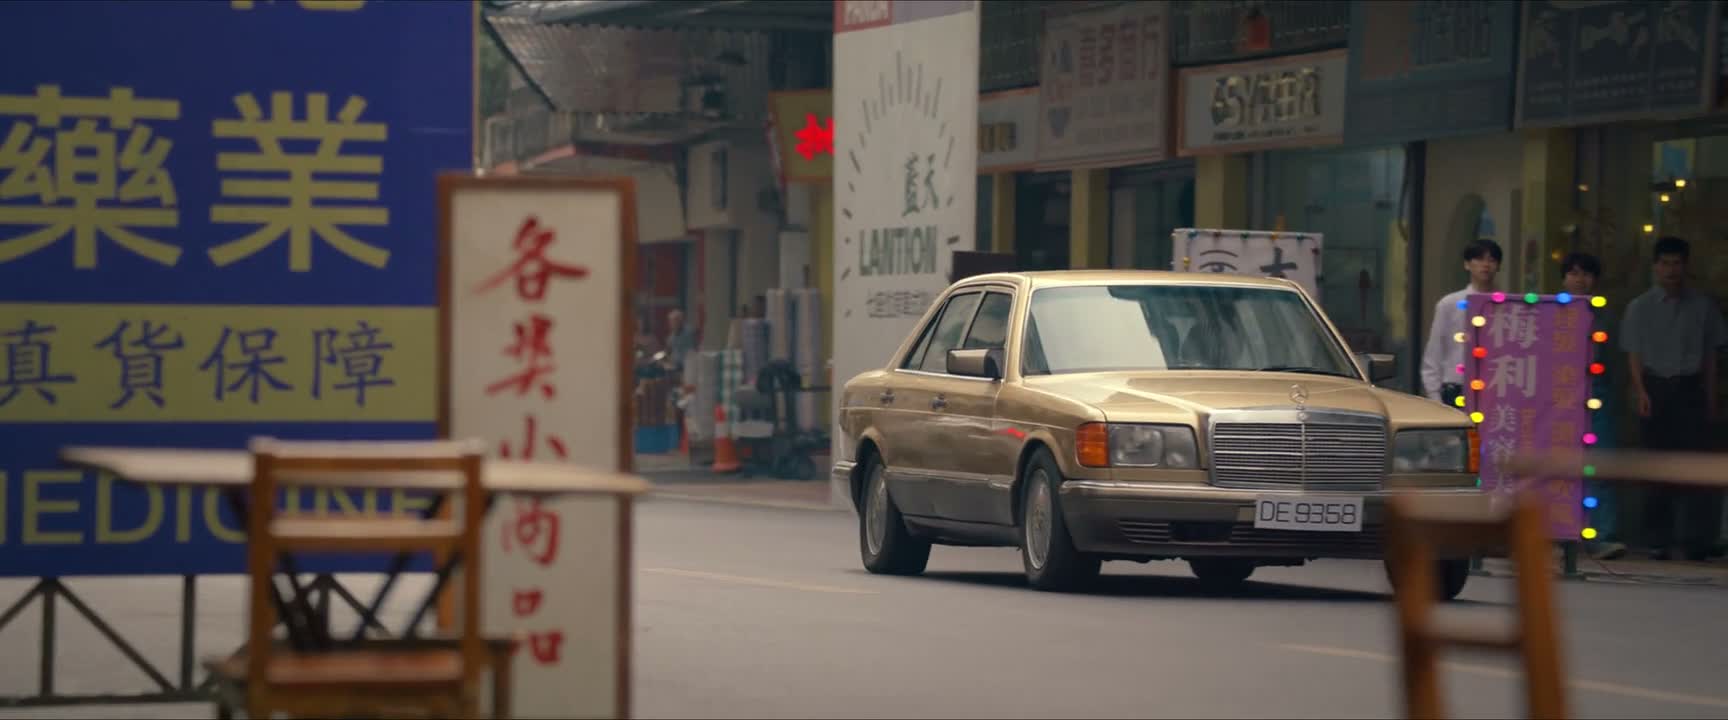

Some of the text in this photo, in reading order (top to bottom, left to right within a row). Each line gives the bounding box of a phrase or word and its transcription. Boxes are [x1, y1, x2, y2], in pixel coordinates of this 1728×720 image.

[0, 85, 391, 272] 藥業
[859, 225, 937, 277] LANTION
[0, 320, 397, 410] 真貨保障
[1487, 304, 1540, 399] 梅利
[1260, 500, 1356, 525] DE 9358
